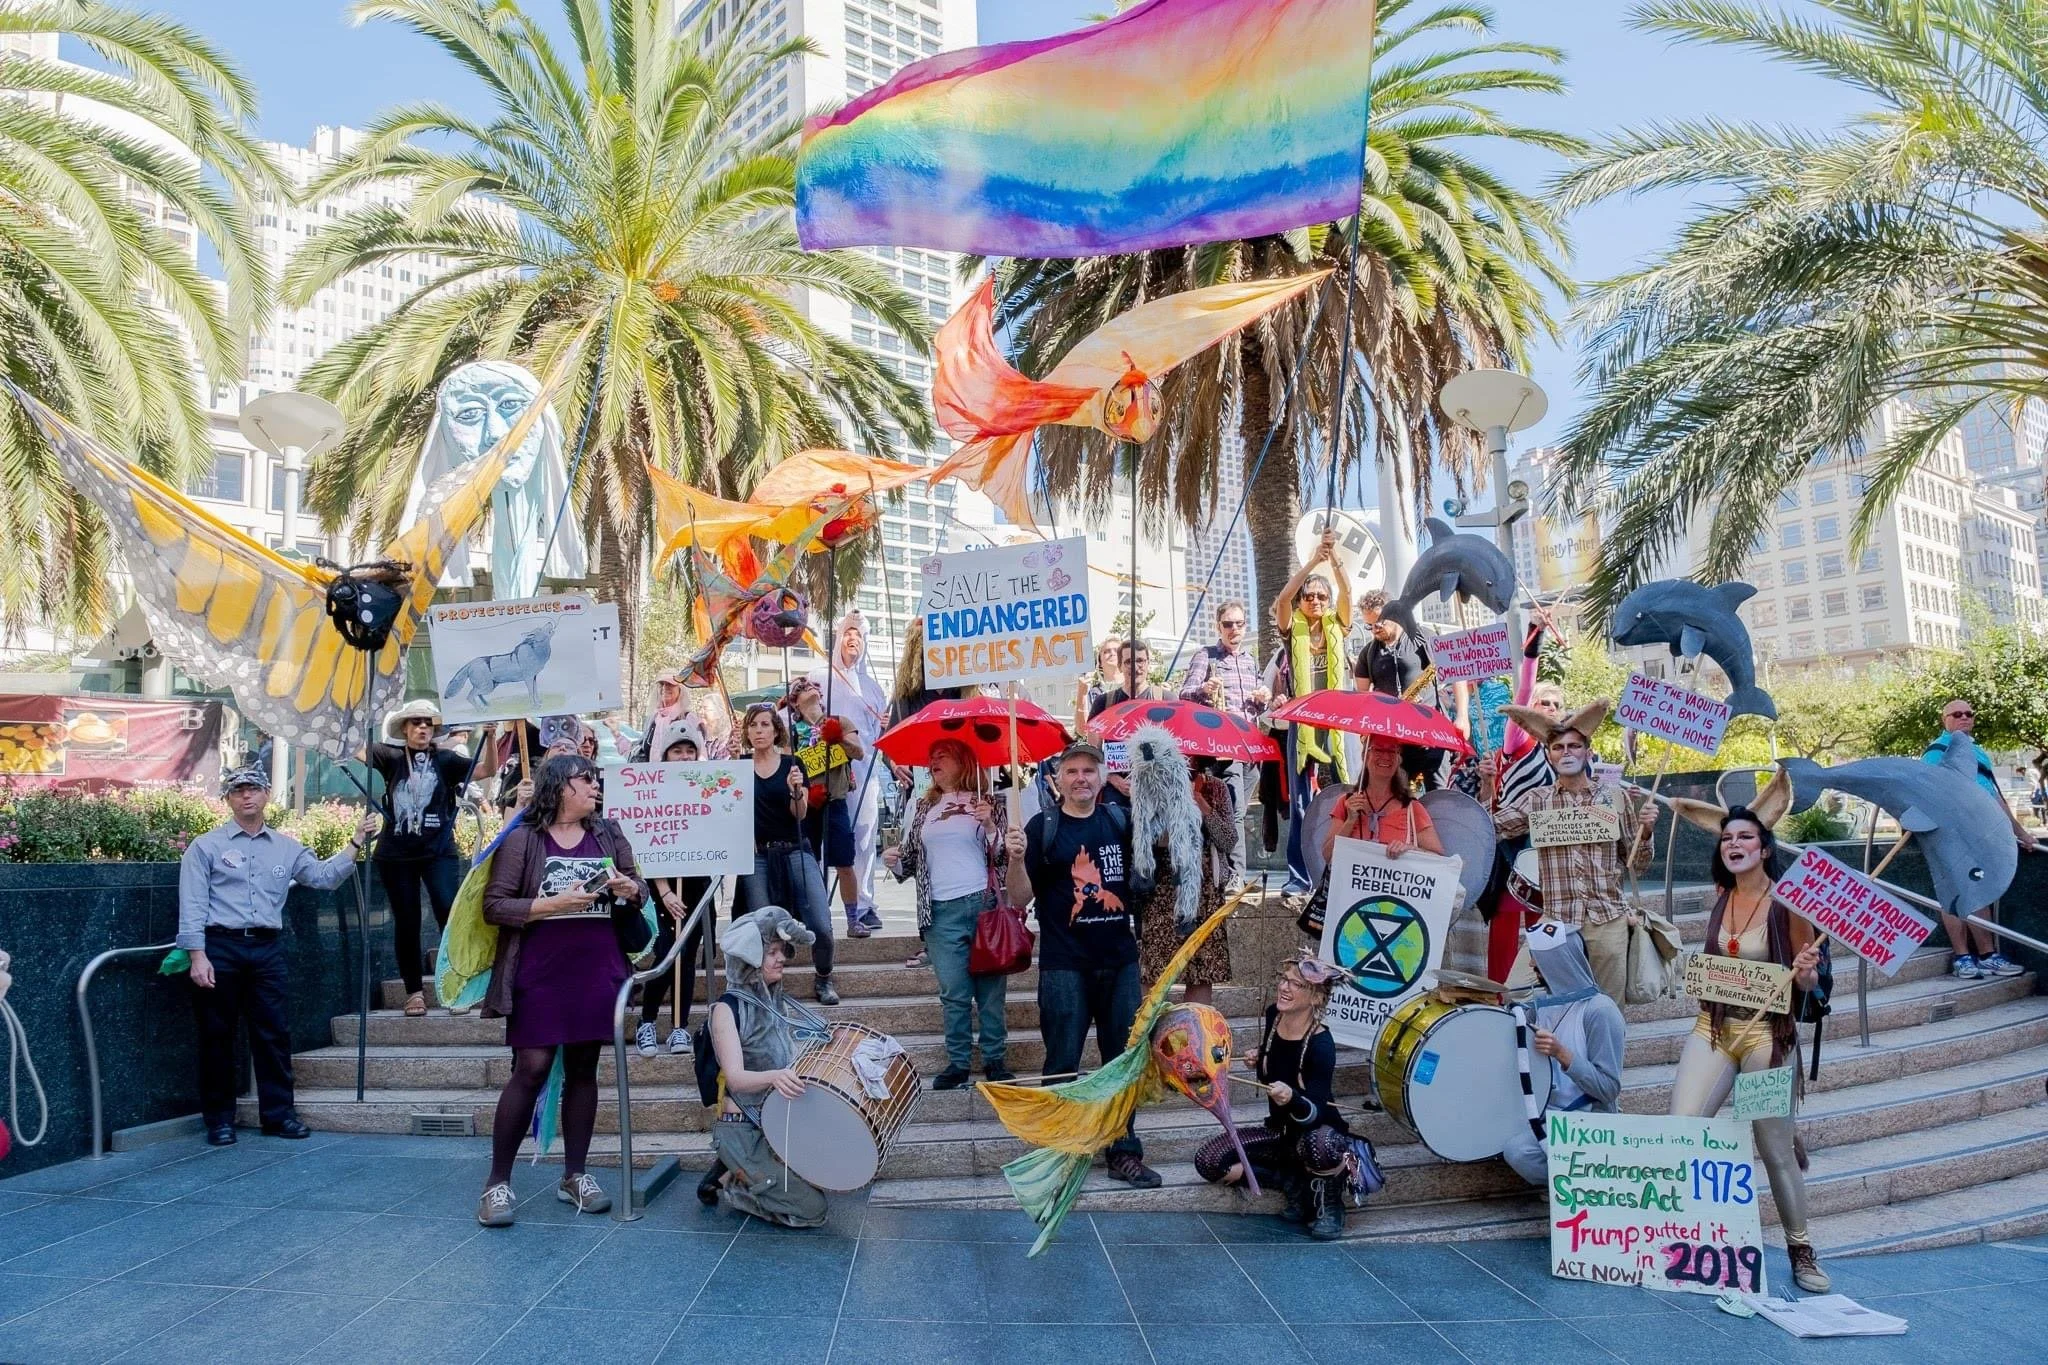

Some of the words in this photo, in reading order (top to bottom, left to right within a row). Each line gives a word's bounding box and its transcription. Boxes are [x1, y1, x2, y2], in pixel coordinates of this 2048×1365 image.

[1542, 543, 1566, 563] Harry
[1567, 537, 1595, 558] Potter
[928, 570, 1001, 609] SAVE
[1007, 574, 1040, 596] THE
[927, 593, 1088, 641] ENDANGERED
[1434, 638, 1455, 653] SAVE
[1456, 637, 1470, 649] THE
[1468, 629, 1507, 646] VAQUITA
[927, 639, 1025, 679] SPECIES
[1030, 630, 1089, 669] ACT
[1448, 652, 1462, 662] THE
[1437, 663, 1475, 682] SMALLEST
[1475, 657, 1513, 675] PORPOISE
[1631, 675, 1660, 692] SAVE
[1663, 685, 1683, 700] THE
[1685, 693, 1728, 720] VAQUITA
[1632, 690, 1656, 706] THE
[1658, 700, 1673, 715] CA
[1678, 708, 1700, 724] BAY
[1702, 718, 1714, 730] IS
[1291, 702, 1326, 720] house
[1327, 713, 1338, 723] is
[1359, 716, 1391, 734] fire!
[1395, 723, 1428, 739] Your
[1620, 704, 1647, 725] OUR
[1650, 717, 1680, 736] ONLY
[1682, 727, 1716, 751] HOME
[1175, 737, 1204, 751] ome.
[1207, 737, 1242, 755] Your
[634, 789, 657, 801] THE
[608, 803, 712, 821] ENDANGERED
[635, 819, 689, 834] SPECIES
[1547, 822, 1583, 830] PESTICIDES
[649, 833, 679, 847] ACT
[1099, 844, 1123, 856] SAVE
[636, 850, 728, 864] TECTSPECIES.ORG
[1100, 854, 1124, 869] THE
[1351, 863, 1437, 887] EXTINCTION
[1351, 877, 1433, 900] REBELLION
[1801, 850, 1846, 887] SAVE
[1842, 876, 1871, 904] THE
[1867, 893, 1930, 944] VAQUITA
[1802, 874, 1828, 896] WE
[1825, 891, 1859, 918] LIVE
[1855, 910, 1875, 929] IN
[1872, 921, 1900, 945] THE
[1776, 880, 1866, 947] CALIFORNIA
[1860, 937, 1896, 967] BAY
[1685, 983, 1703, 996] GAS
[1687, 972, 1703, 983] OIL
[1550, 1115, 1616, 1147] Nixon
[1622, 1133, 1664, 1148] signed
[1670, 1135, 1695, 1146] into
[1702, 1129, 1739, 1151] law
[1552, 1153, 1570, 1162] the
[1568, 1151, 1688, 1183] Endangered
[1690, 1158, 1754, 1205] 1973
[1553, 1174, 1639, 1214] Species
[1638, 1181, 1685, 1213] Act
[1556, 1209, 1640, 1254] Trump
[1644, 1221, 1701, 1243] gutted
[1709, 1221, 1729, 1244] it
[1556, 1258, 1587, 1277] ACT
[1591, 1263, 1644, 1286] NOW!
[1636, 1251, 1655, 1270] in
[1665, 1242, 1763, 1294] 2019
